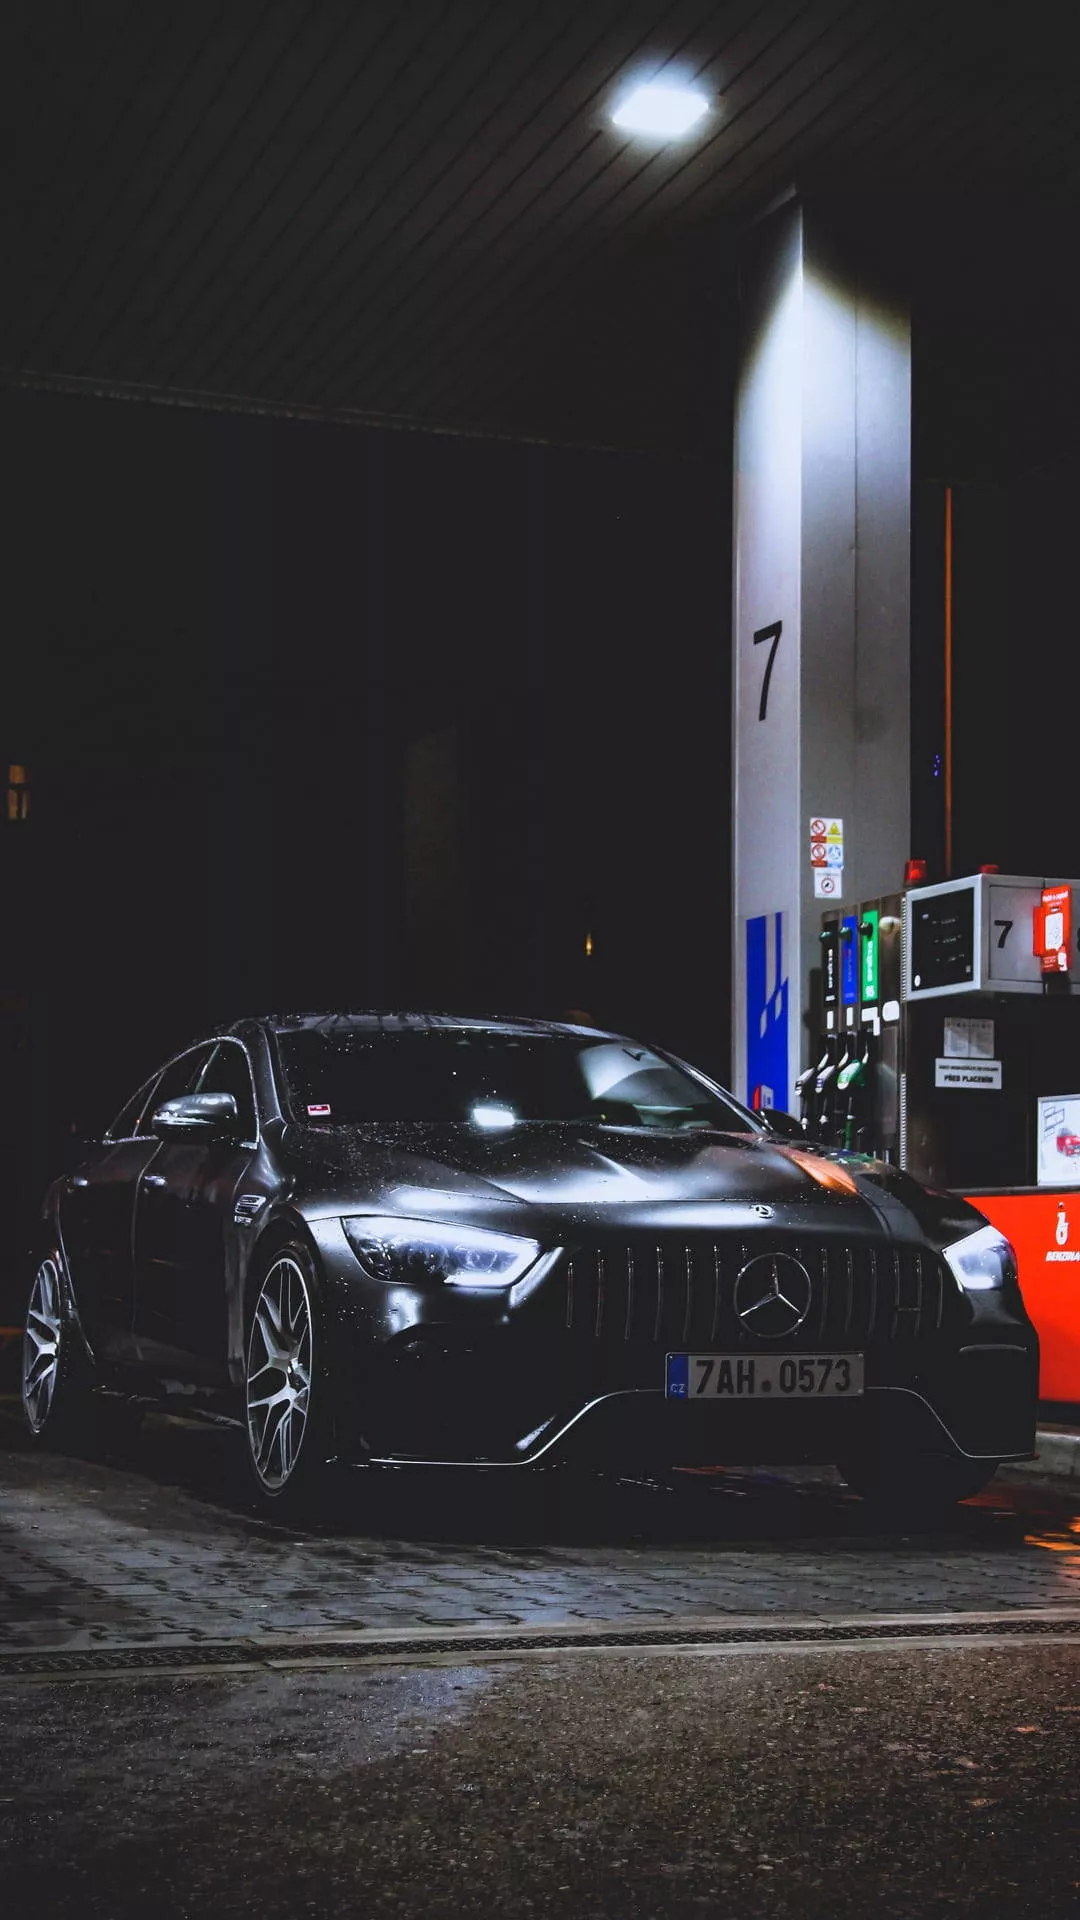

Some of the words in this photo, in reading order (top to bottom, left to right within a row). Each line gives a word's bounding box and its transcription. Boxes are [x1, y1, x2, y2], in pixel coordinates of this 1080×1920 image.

[753, 620, 783, 722] 7
[994, 920, 1014, 949] 7
[669, 1383, 685, 1394] CZ
[696, 1359, 756, 1394] 7AH
[779, 1358, 851, 1394] 0573
